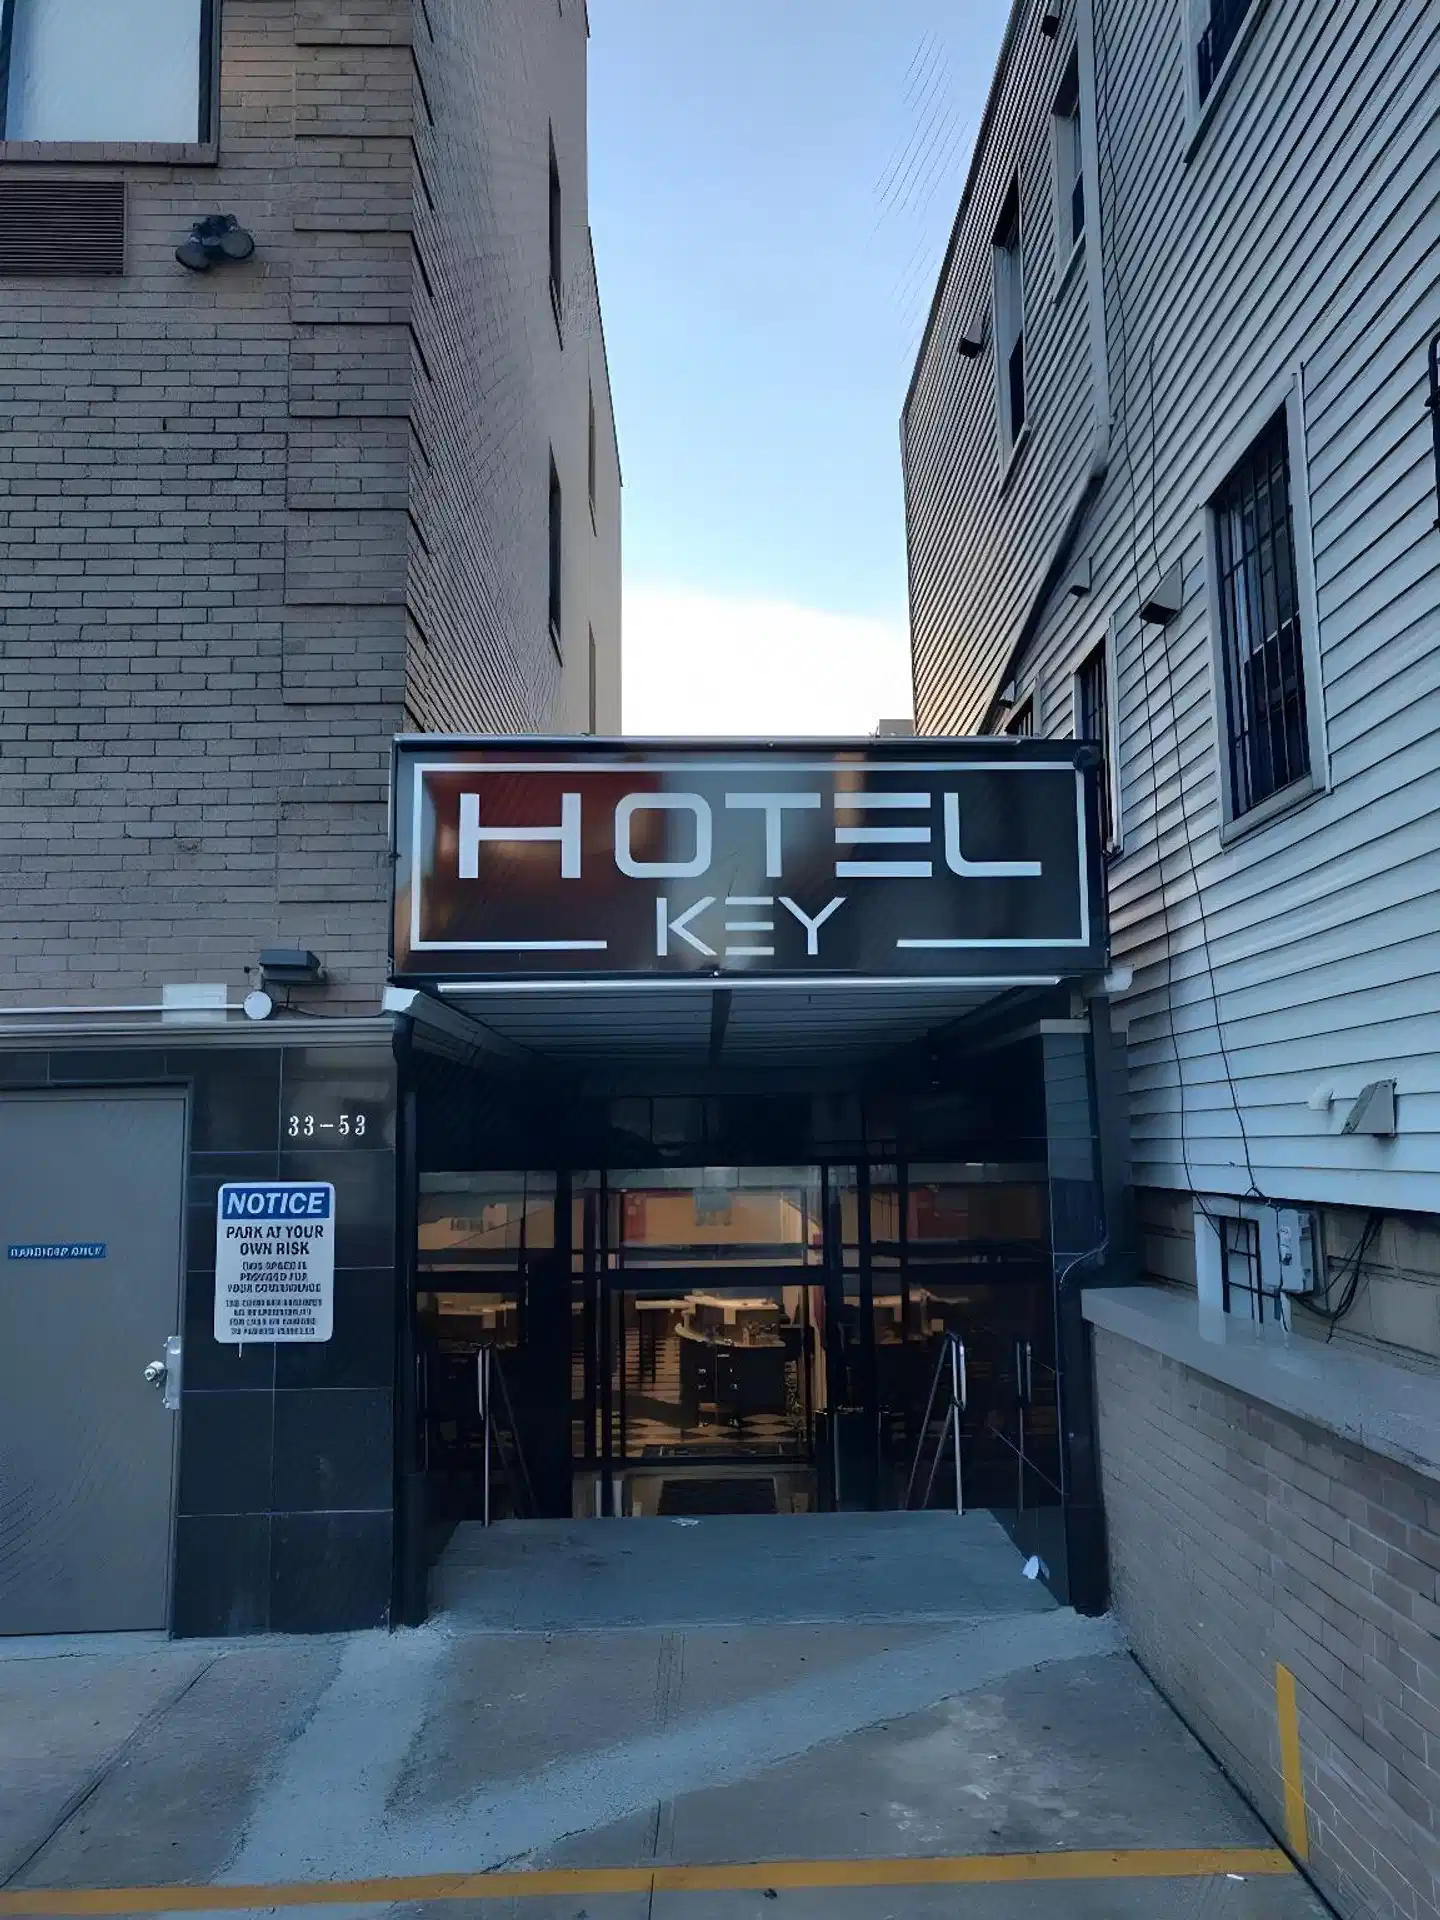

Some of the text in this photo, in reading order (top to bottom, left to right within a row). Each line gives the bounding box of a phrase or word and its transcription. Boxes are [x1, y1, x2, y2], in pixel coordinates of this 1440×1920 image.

[458, 792, 1041, 879] HOTEL
[656, 896, 846, 956] KEY
[288, 1114, 366, 1137] 33-53
[227, 1192, 325, 1214] NOTICE
[226, 1225, 324, 1239] PARK AT YOUR
[240, 1242, 309, 1256] OWN RISK
